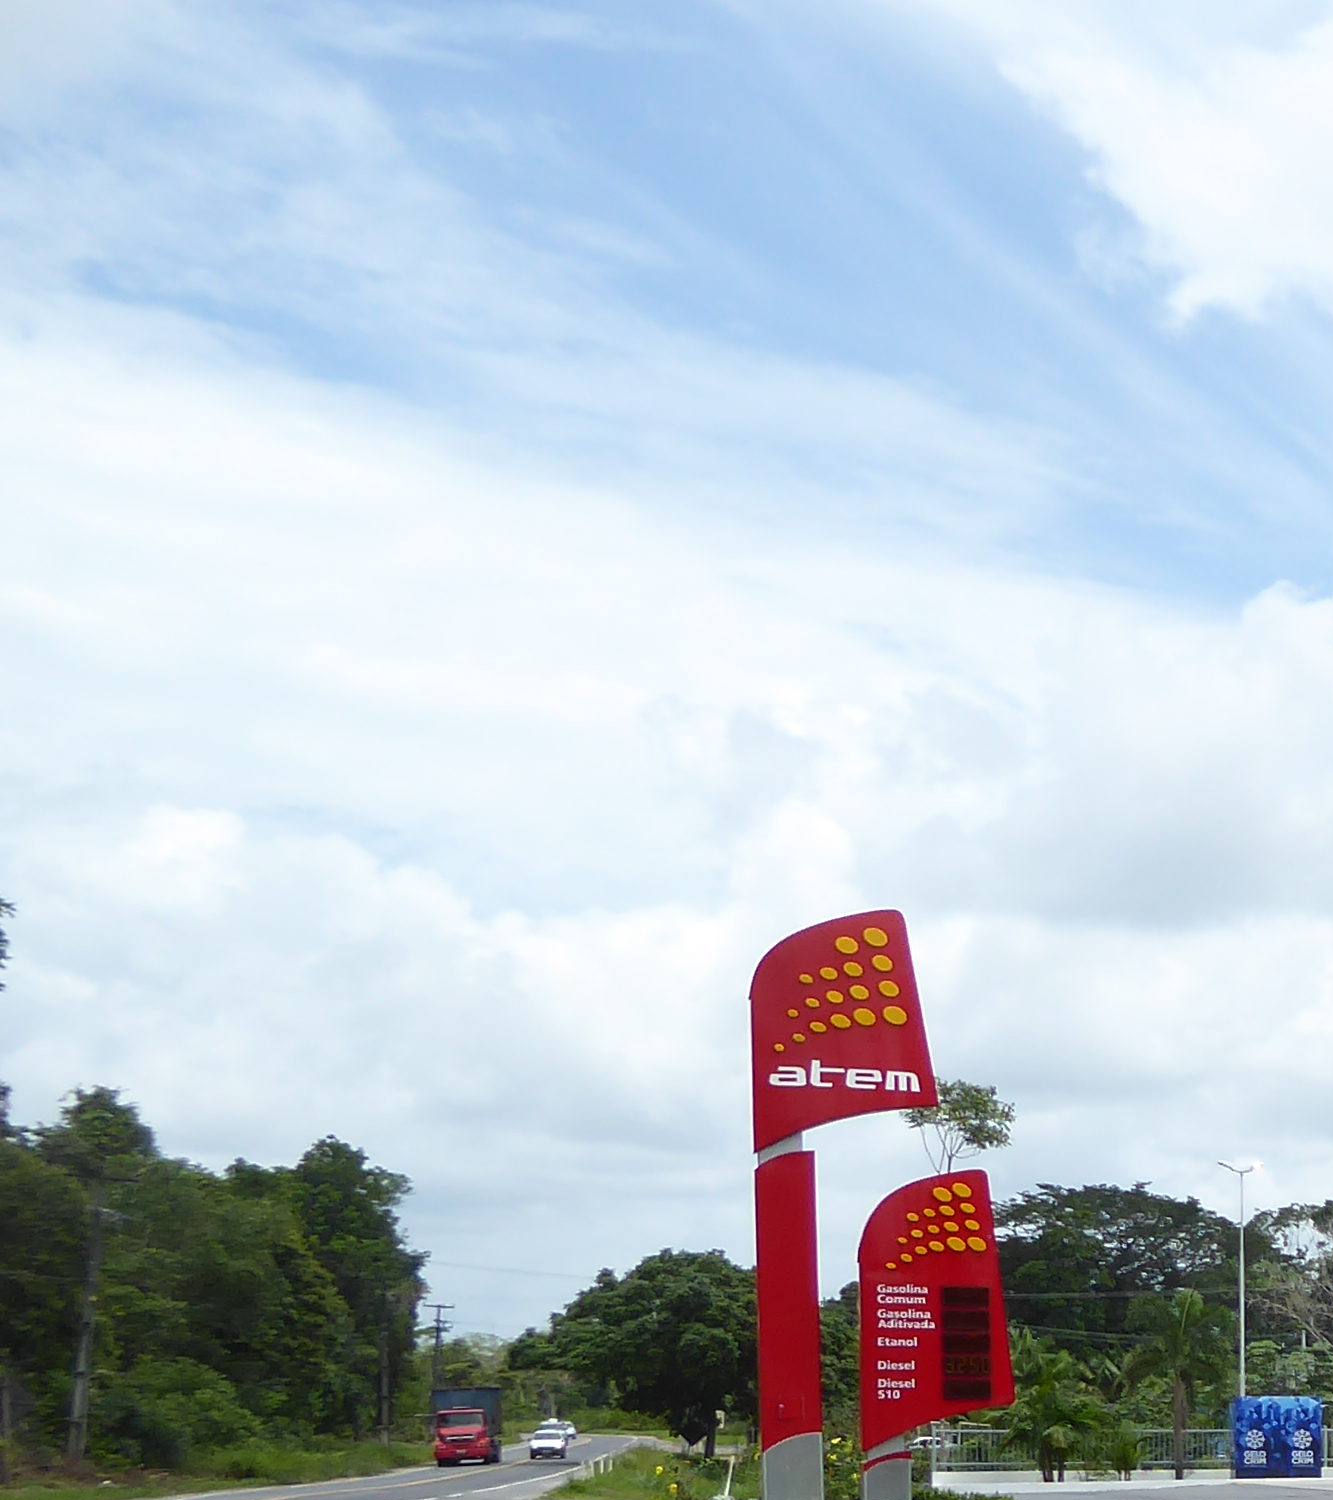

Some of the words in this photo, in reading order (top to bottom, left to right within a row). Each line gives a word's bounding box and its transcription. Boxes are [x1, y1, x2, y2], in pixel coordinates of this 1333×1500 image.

[769, 1059, 921, 1092] atem
[877, 1284, 928, 1294] Gasolina
[877, 1294, 926, 1304] Comum
[877, 1309, 931, 1319] Gasolina
[878, 1319, 935, 1329] Aditivada
[877, 1337, 918, 1347] Etanol
[877, 1360, 915, 1370] Diesel
[877, 1378, 915, 1388] Diesel
[878, 1390, 900, 1399] S10
